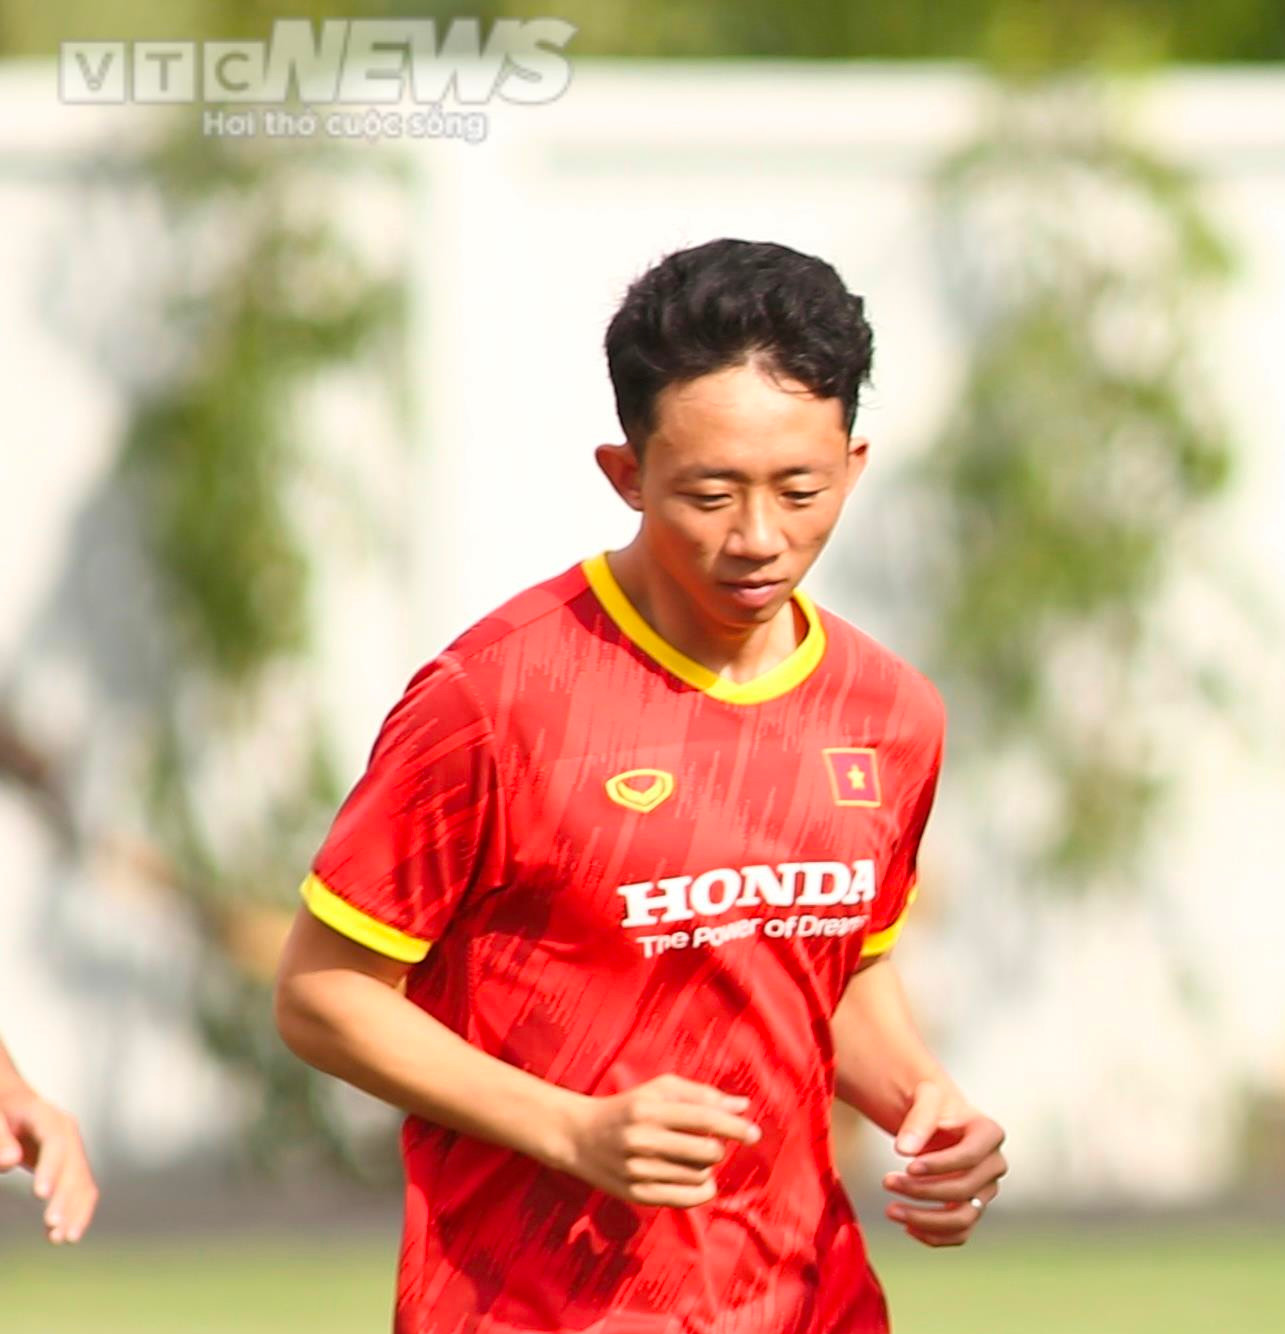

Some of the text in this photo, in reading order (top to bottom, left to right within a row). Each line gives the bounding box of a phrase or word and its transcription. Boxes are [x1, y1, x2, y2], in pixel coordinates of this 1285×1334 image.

[617, 859, 876, 928] HONDA
[636, 931, 690, 959] The
[692, 917, 763, 949] Power
[764, 915, 799, 940] of
